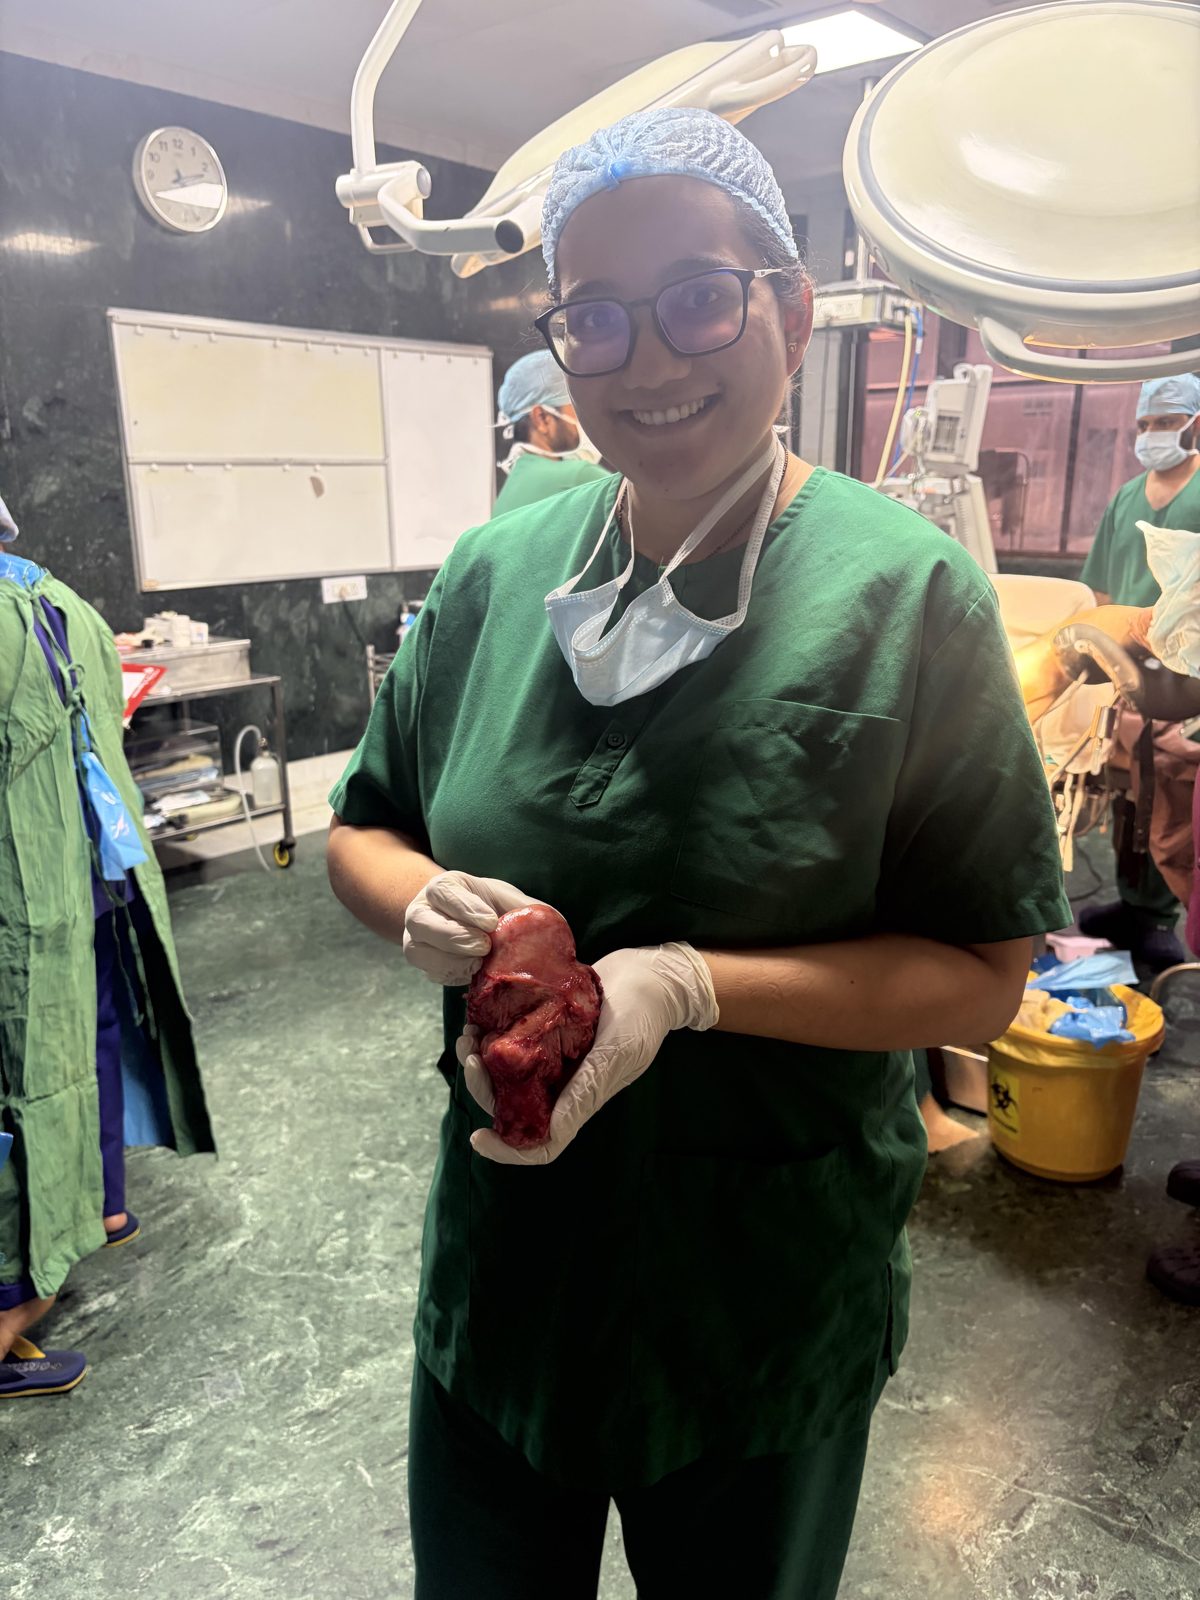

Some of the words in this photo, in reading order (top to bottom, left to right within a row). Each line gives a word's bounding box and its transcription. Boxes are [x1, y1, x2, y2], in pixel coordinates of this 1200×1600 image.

[159, 141, 168, 152] 11
[172, 138, 184, 150] 12
[190, 146, 196, 157] 1
[149, 152, 161, 163] 10
[201, 162, 209, 172] 2
